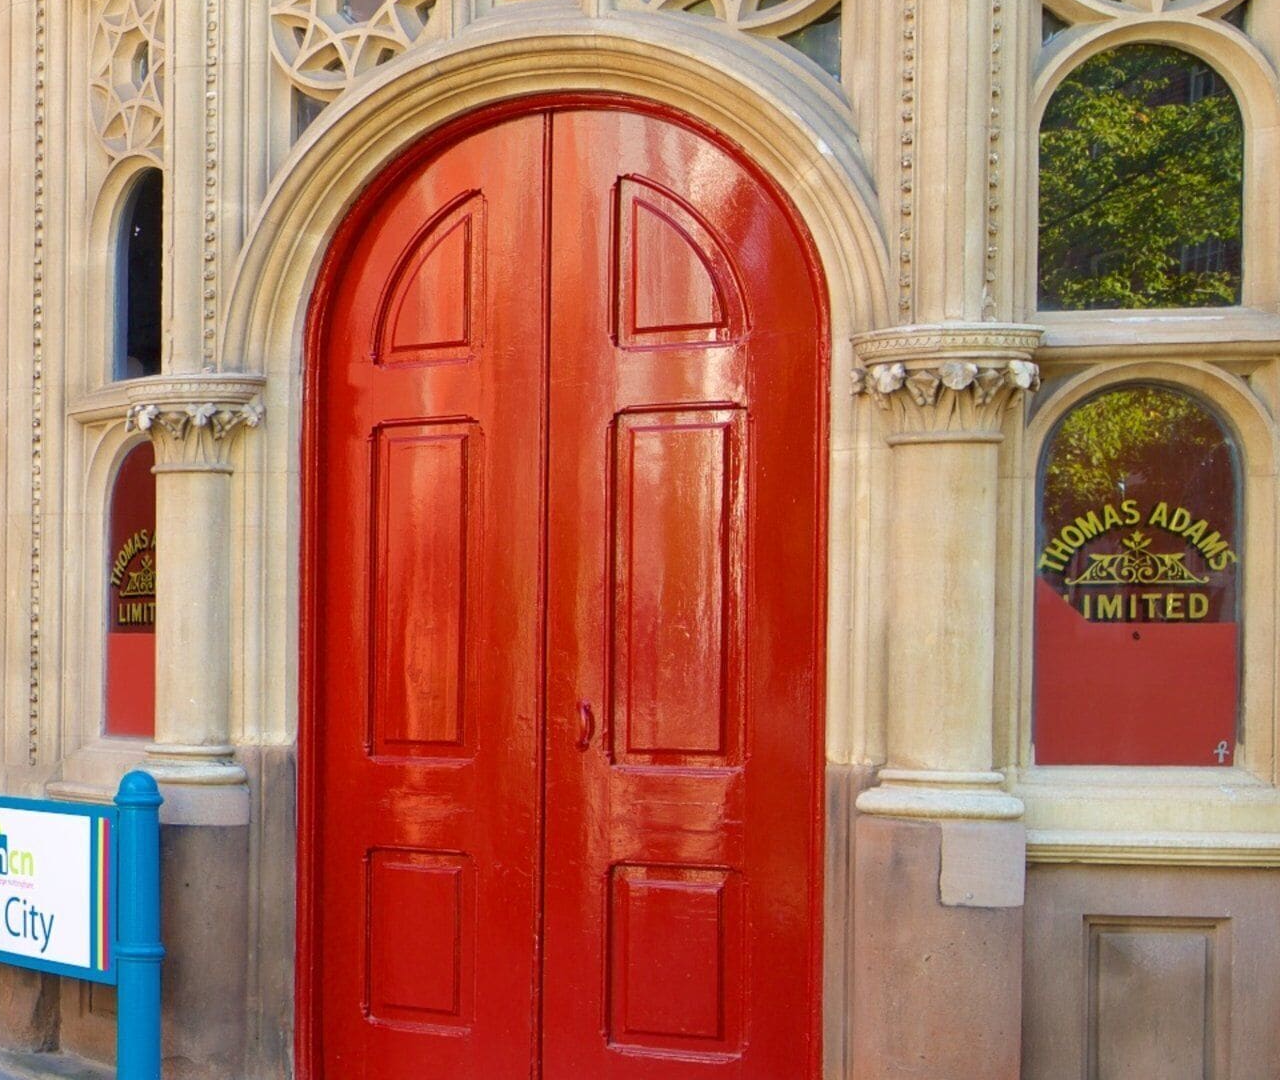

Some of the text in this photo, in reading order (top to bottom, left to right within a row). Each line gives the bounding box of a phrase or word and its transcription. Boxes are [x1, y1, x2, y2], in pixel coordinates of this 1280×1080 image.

[111, 529, 149, 585] THOMAS
[1039, 499, 1238, 571] THOMAS ADAMS
[119, 602, 157, 623] LIMIT
[1062, 592, 1210, 619] IMITED
[5, 896, 54, 953] City
